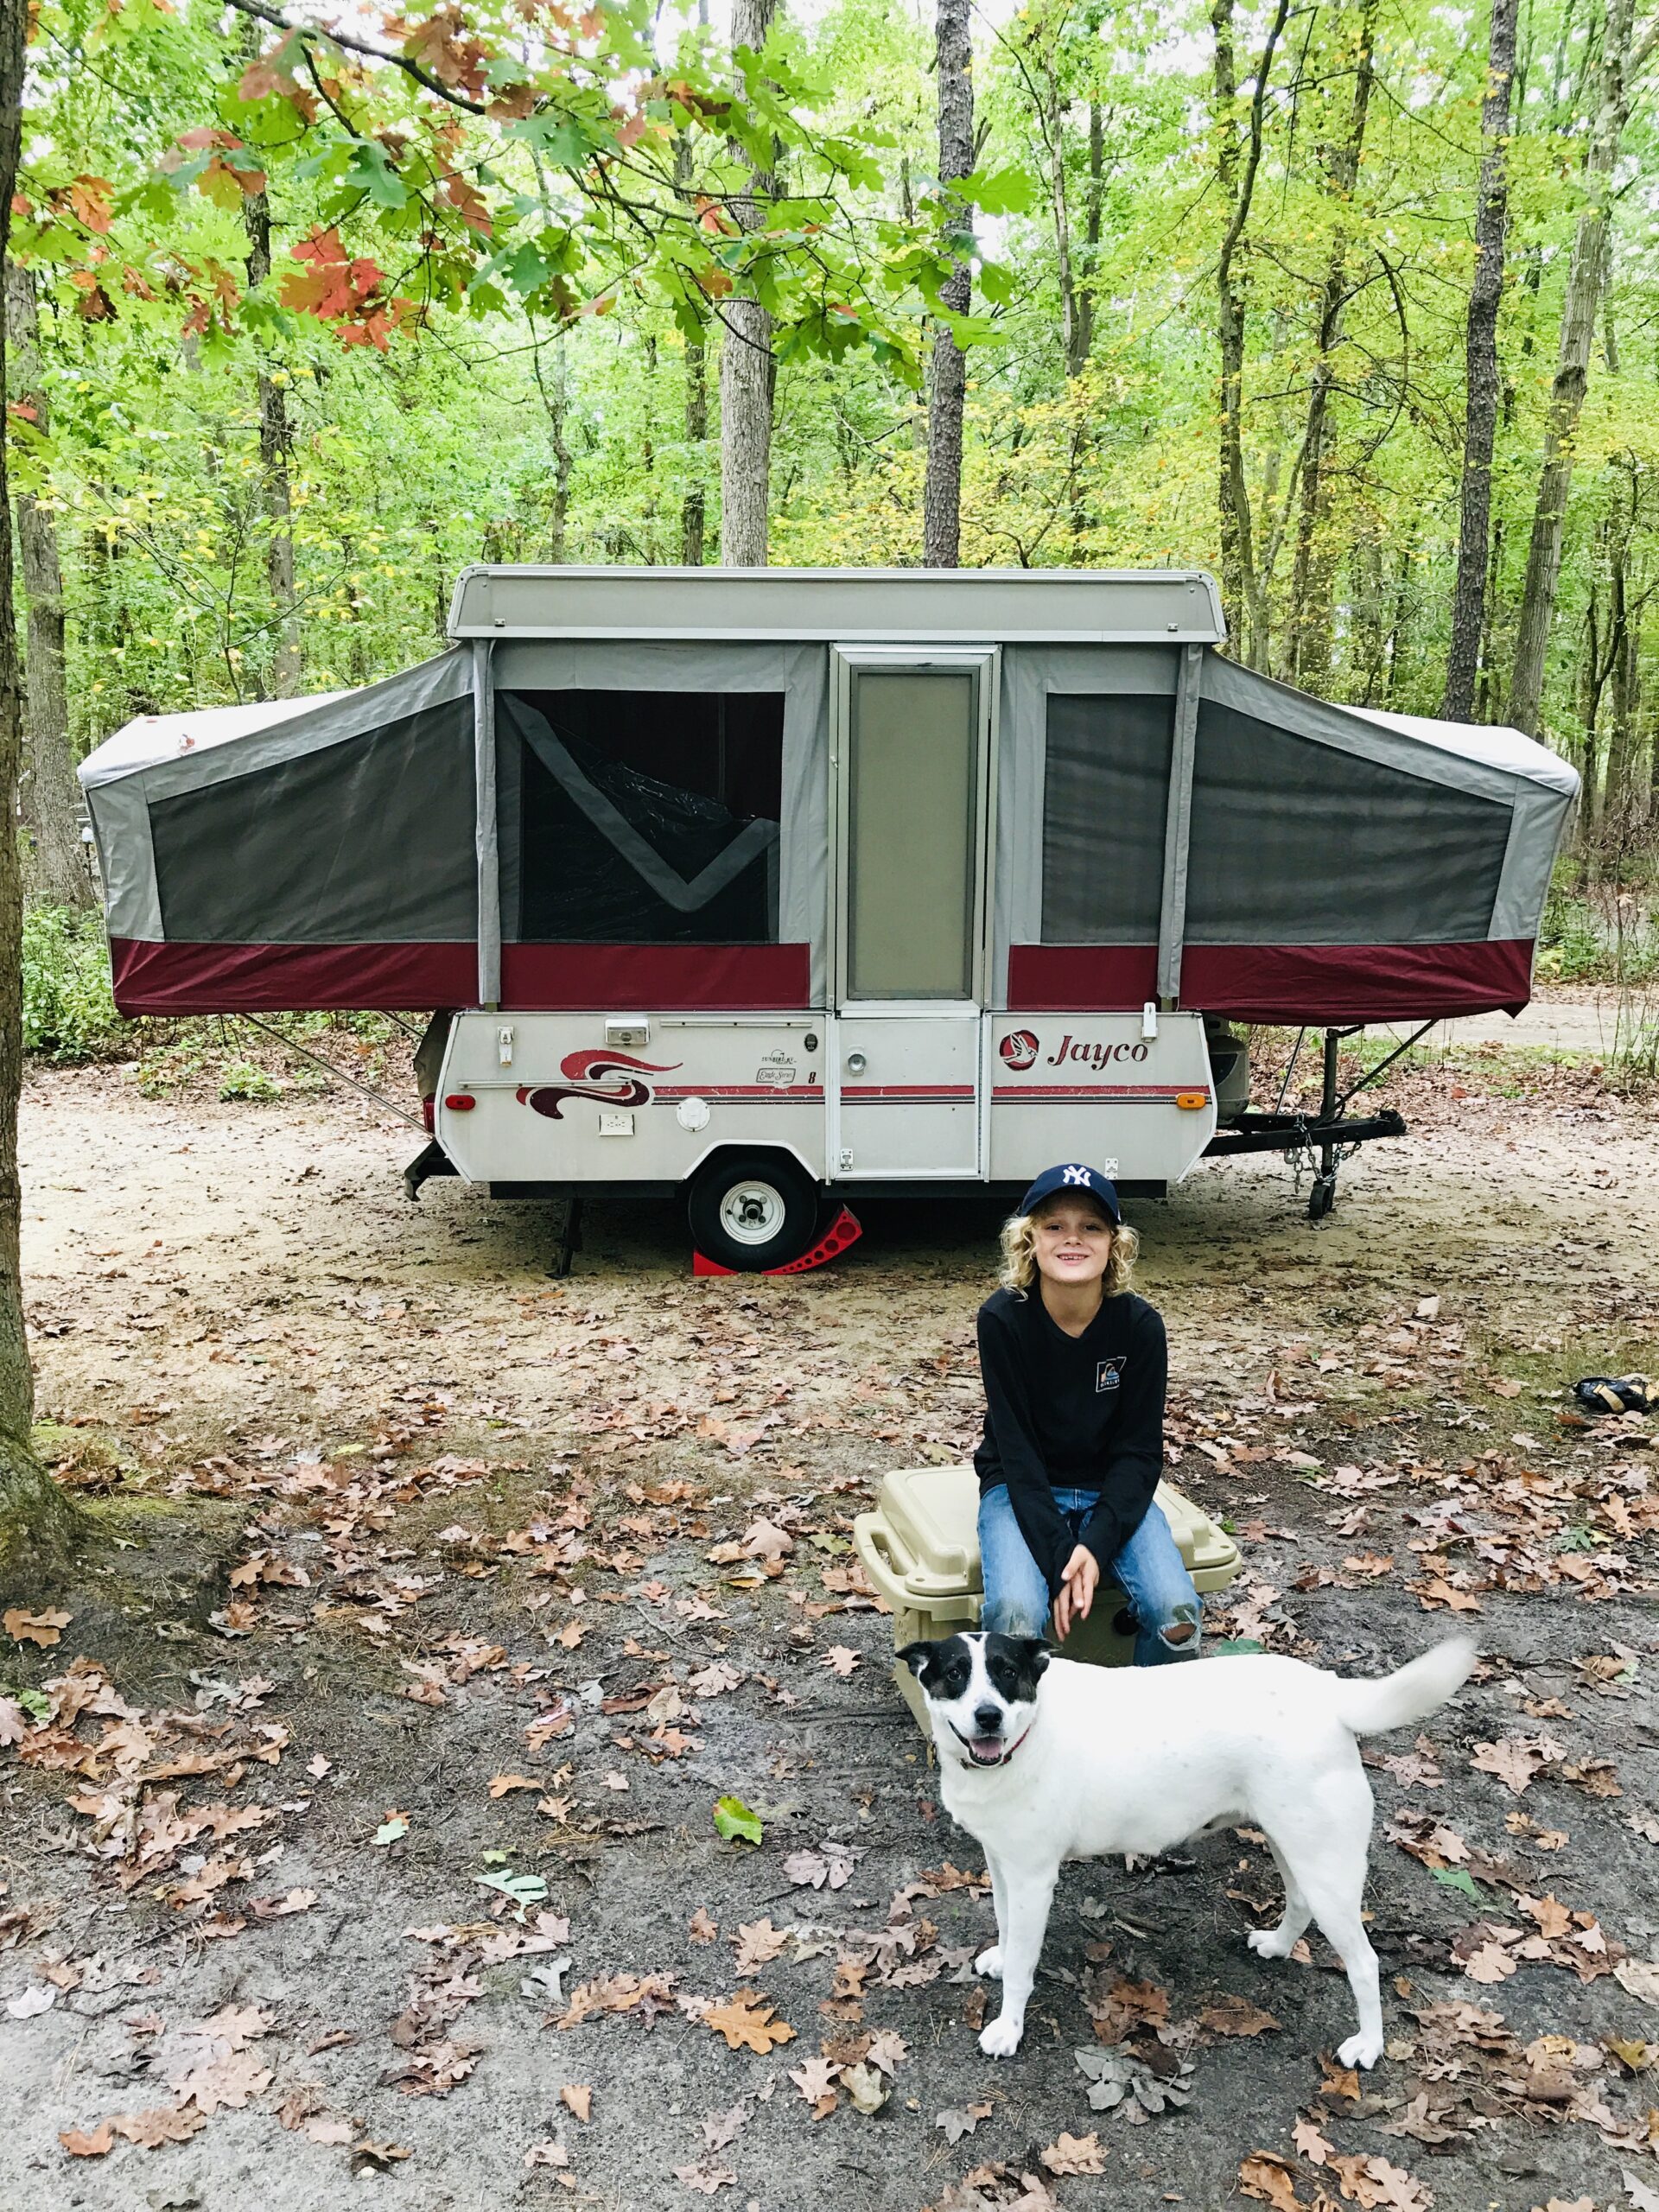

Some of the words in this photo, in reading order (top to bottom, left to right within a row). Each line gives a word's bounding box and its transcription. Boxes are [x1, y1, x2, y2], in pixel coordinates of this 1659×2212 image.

[1047, 1035, 1148, 1071] Jayco
[808, 1071, 817, 1084] 8
[1063, 1165, 1091, 1187] NY
